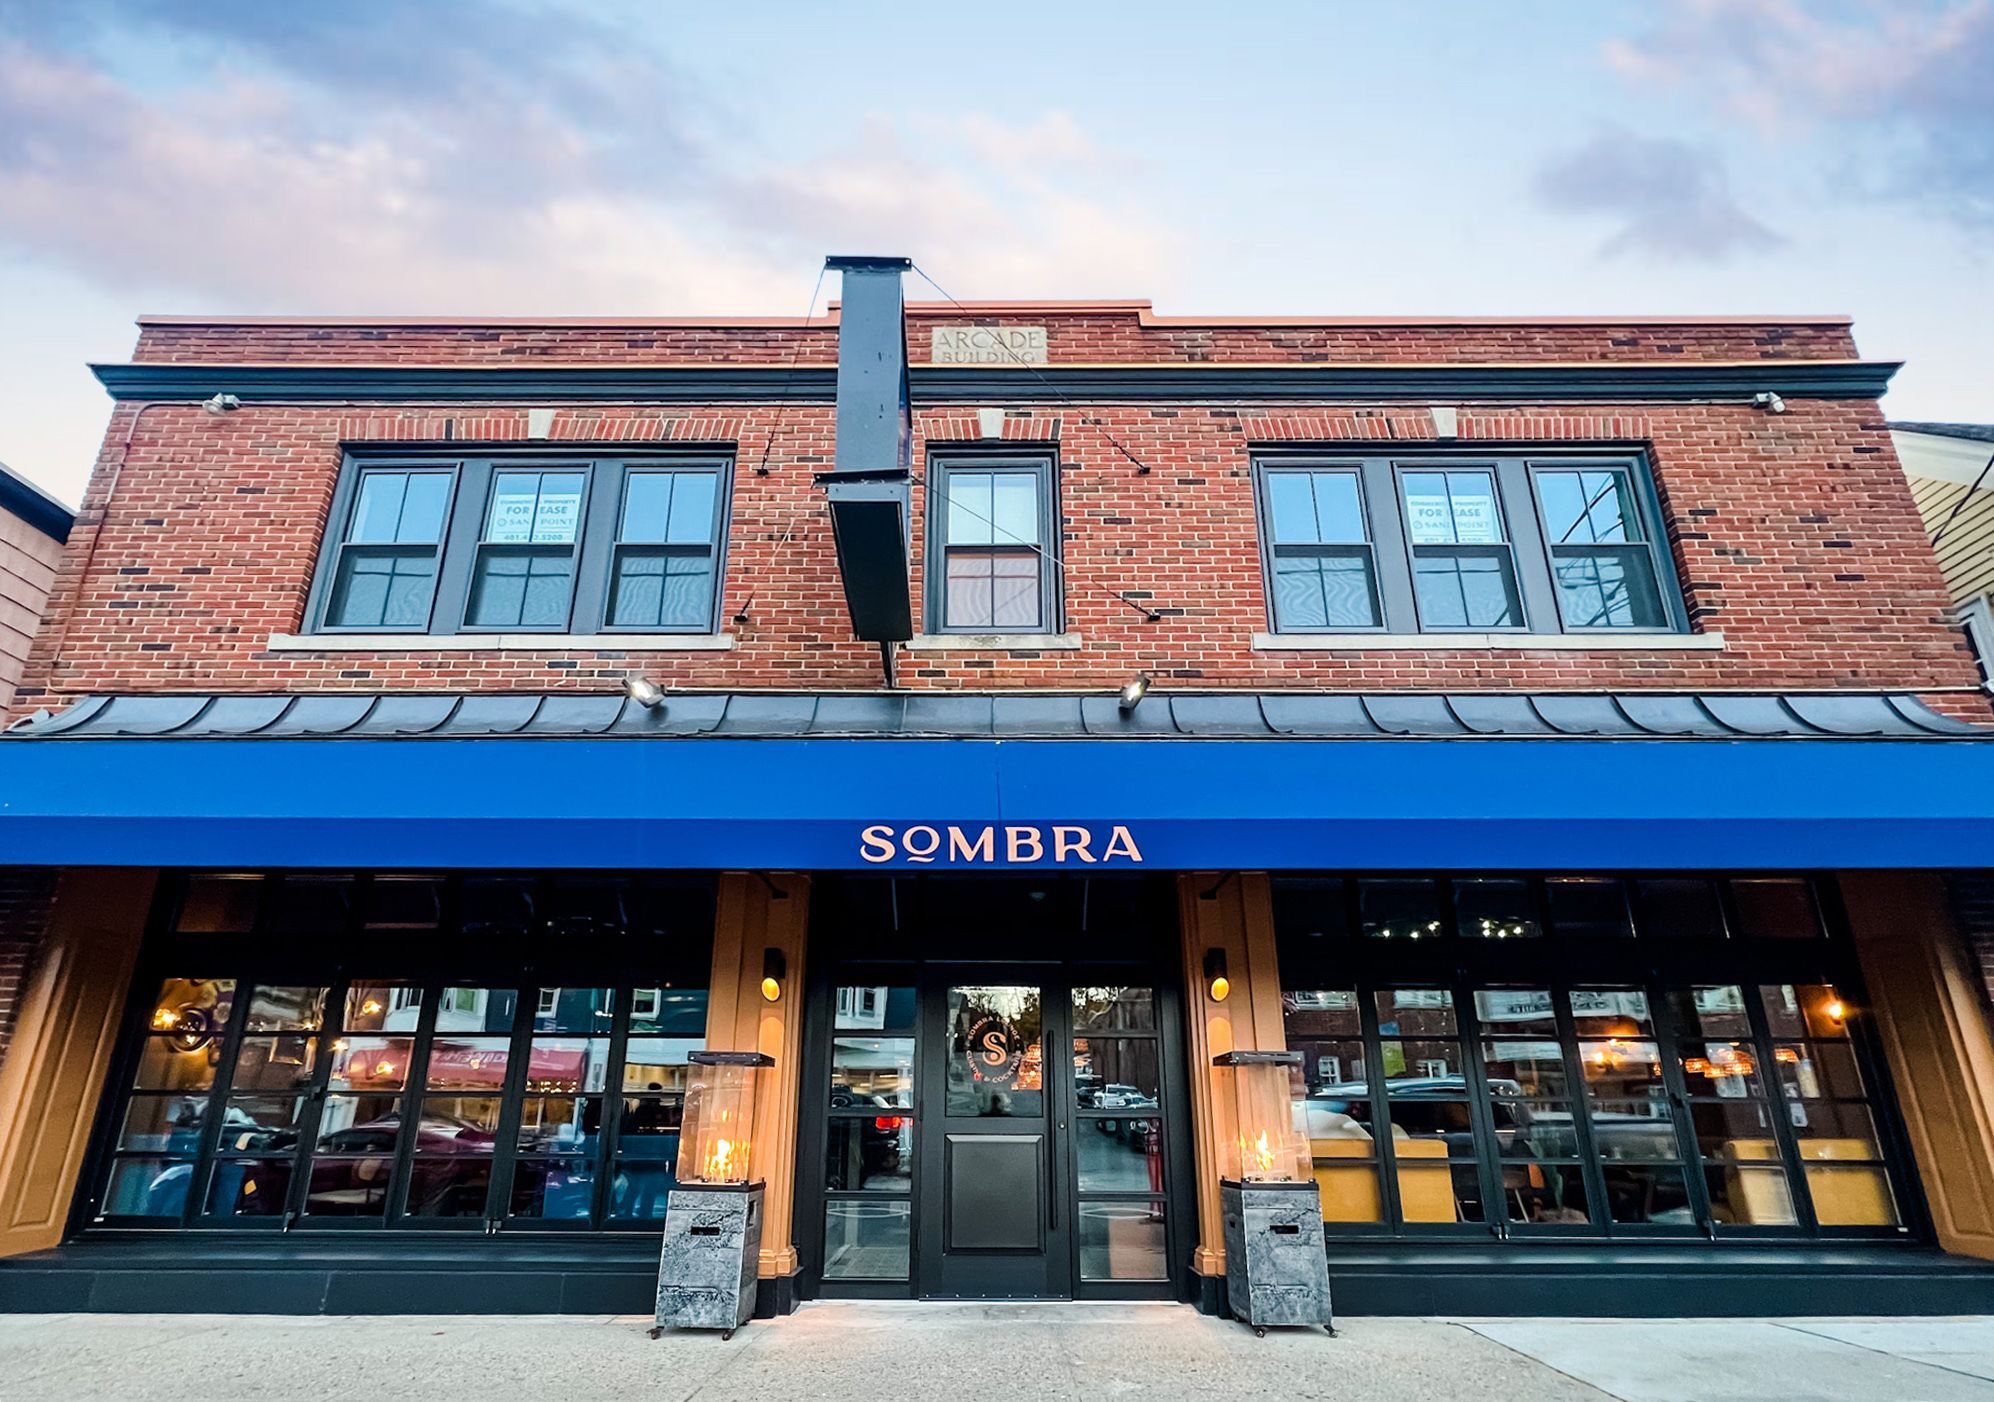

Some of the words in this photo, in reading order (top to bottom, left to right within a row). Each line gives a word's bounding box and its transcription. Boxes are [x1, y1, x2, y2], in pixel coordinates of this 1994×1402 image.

[936, 331, 1043, 349] ARCADE
[942, 352, 1035, 363] BUILDING
[506, 506, 531, 515] FOR
[539, 506, 568, 514] EASE
[1418, 509, 1443, 517] FOR
[860, 825, 1143, 863] SOMBRA
[967, 1015, 994, 1041] SOMBRA
